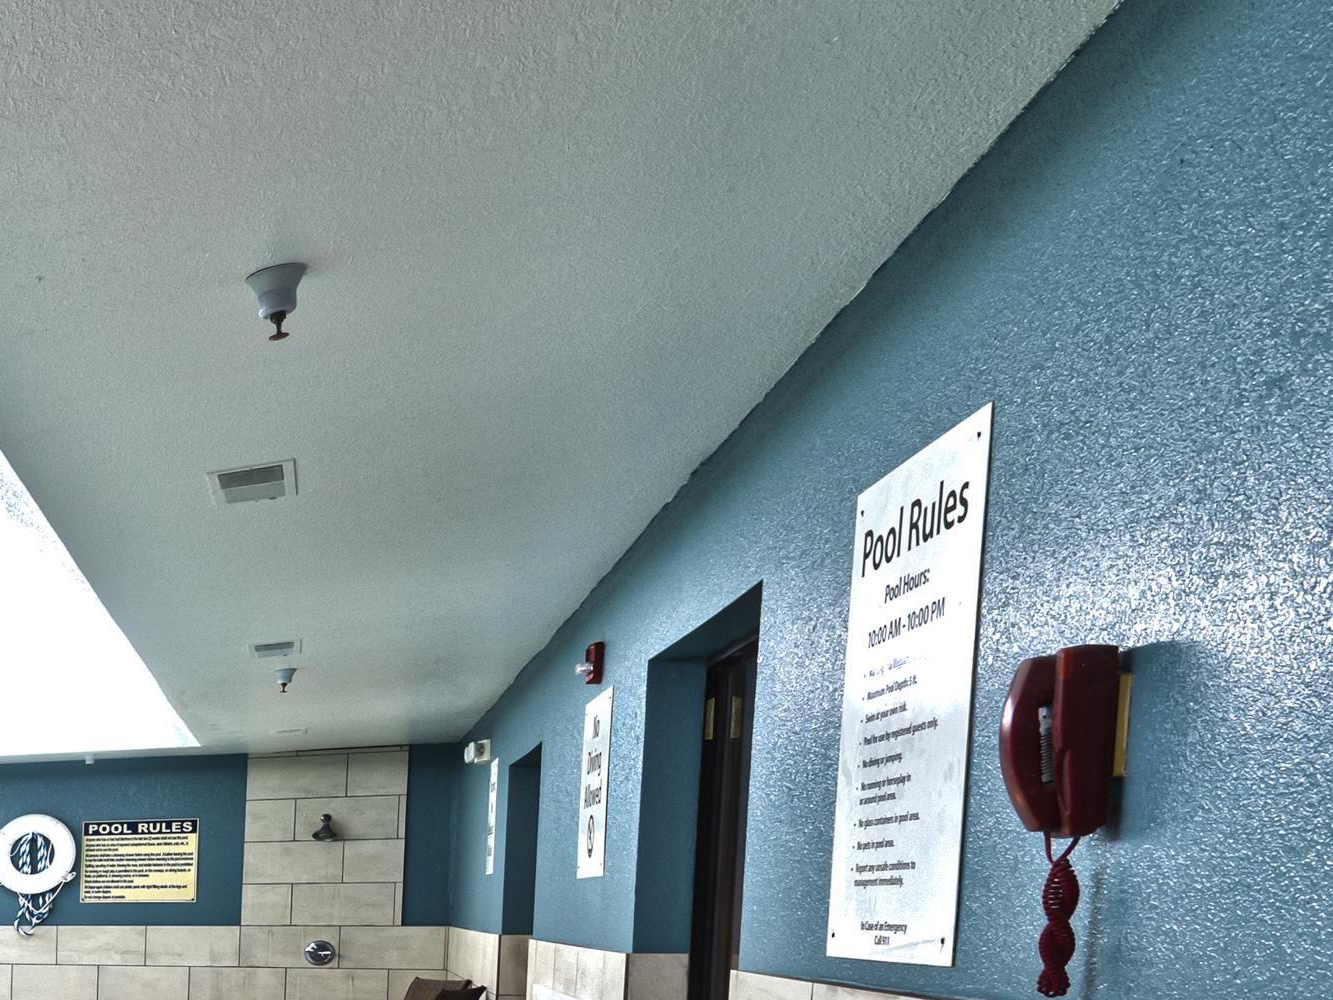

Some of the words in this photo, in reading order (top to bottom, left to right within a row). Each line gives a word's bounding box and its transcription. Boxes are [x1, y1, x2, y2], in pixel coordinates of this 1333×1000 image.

[861, 505, 905, 578] Pool
[907, 480, 970, 552] Rules
[884, 575, 903, 604] Pool
[902, 568, 931, 594] Hours:
[868, 624, 887, 648] 10:00
[888, 616, 902, 641] AM
[907, 605, 930, 632] 10:00
[930, 597, 946, 622] PM
[865, 712, 876, 724] Swim
[880, 710, 889, 721] your
[889, 706, 898, 716] own
[877, 733, 885, 743] use
[891, 724, 912, 740] registered
[911, 721, 927, 736] guests
[862, 759, 868, 769] No
[868, 756, 880, 769] diving
[861, 781, 867, 791] No
[866, 779, 882, 791] running
[886, 773, 906, 787] horseplay
[906, 772, 911, 782] in
[876, 791, 887, 805] pool
[88, 823, 133, 835] POOL
[137, 821, 194, 833] RULES
[858, 818, 864, 828] No
[863, 816, 874, 830] glass
[873, 815, 894, 826] containers
[898, 810, 909, 825] pool
[856, 841, 862, 850] No
[861, 840, 871, 852] pets
[874, 837, 885, 852] pool
[855, 863, 869, 875] Report
[888, 859, 910, 871] conditions
[910, 861, 916, 870] to
[854, 878, 878, 889] management
[884, 921, 908, 935] Emergency
